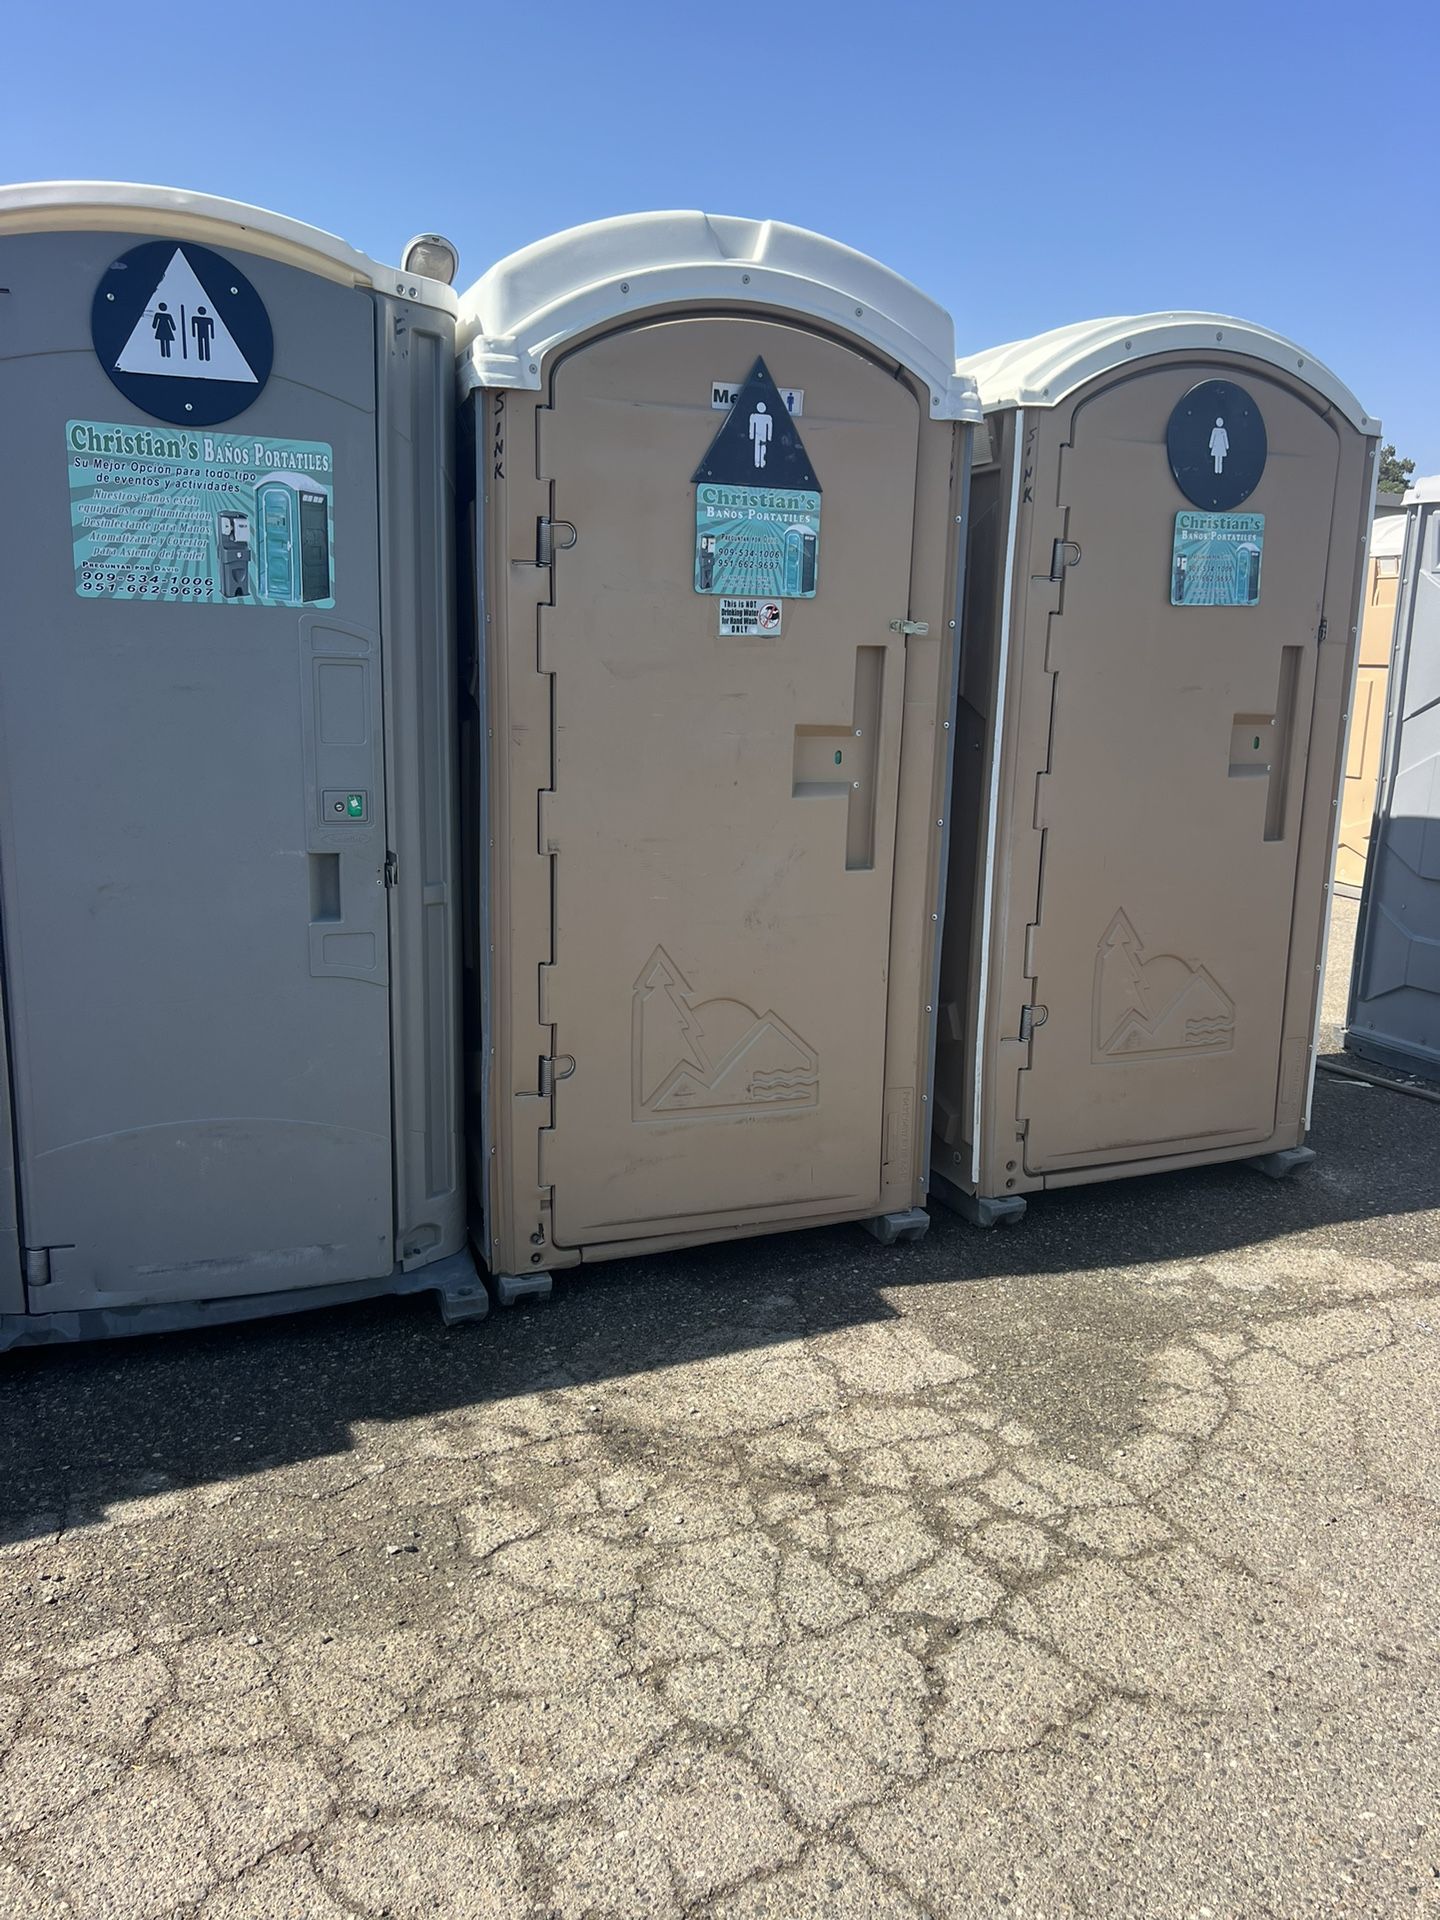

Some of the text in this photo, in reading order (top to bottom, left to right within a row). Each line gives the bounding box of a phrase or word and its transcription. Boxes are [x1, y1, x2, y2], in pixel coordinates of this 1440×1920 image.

[713, 388, 738, 404] Me
[493, 390, 505, 480] SINK
[70, 424, 200, 461] Christian's
[254, 443, 329, 472] PORTATILES
[74, 457, 89, 468] Su
[93, 459, 126, 473] Mejor
[175, 467, 201, 478] para
[205, 469, 230, 479] todo
[235, 471, 256, 482] tipo
[1022, 426, 1037, 504] SINK
[96, 473, 240, 493] de eventos y actividades
[92, 488, 139, 502] Nuestros
[702, 488, 815, 511] Christian's
[78, 503, 130, 516] equipados
[131, 507, 151, 517] con
[747, 508, 811, 524] PORTATILES
[82, 516, 152, 531] Desinfectante
[152, 522, 177, 534] para
[1180, 514, 1261, 531] Christian's
[88, 531, 157, 545] Aromatizante
[158, 536, 167, 547] y
[1210, 531, 1257, 542] PORTATILES
[92, 546, 205, 561] para Asiento del Toilet
[717, 547, 780, 559] 909-534-1006
[81, 560, 180, 573] PREGUNTAR POR DAVID
[717, 558, 780, 569] 951-662-9697
[81, 571, 214, 587] 909-534-1006
[82, 581, 214, 597] 951-662-9697
[723, 599, 757, 609] This is NOT
[721, 608, 759, 617] Drinking Water
[730, 616, 743, 625] Hand
[744, 617, 758, 625] Wash
[731, 625, 748, 633] ONLY
